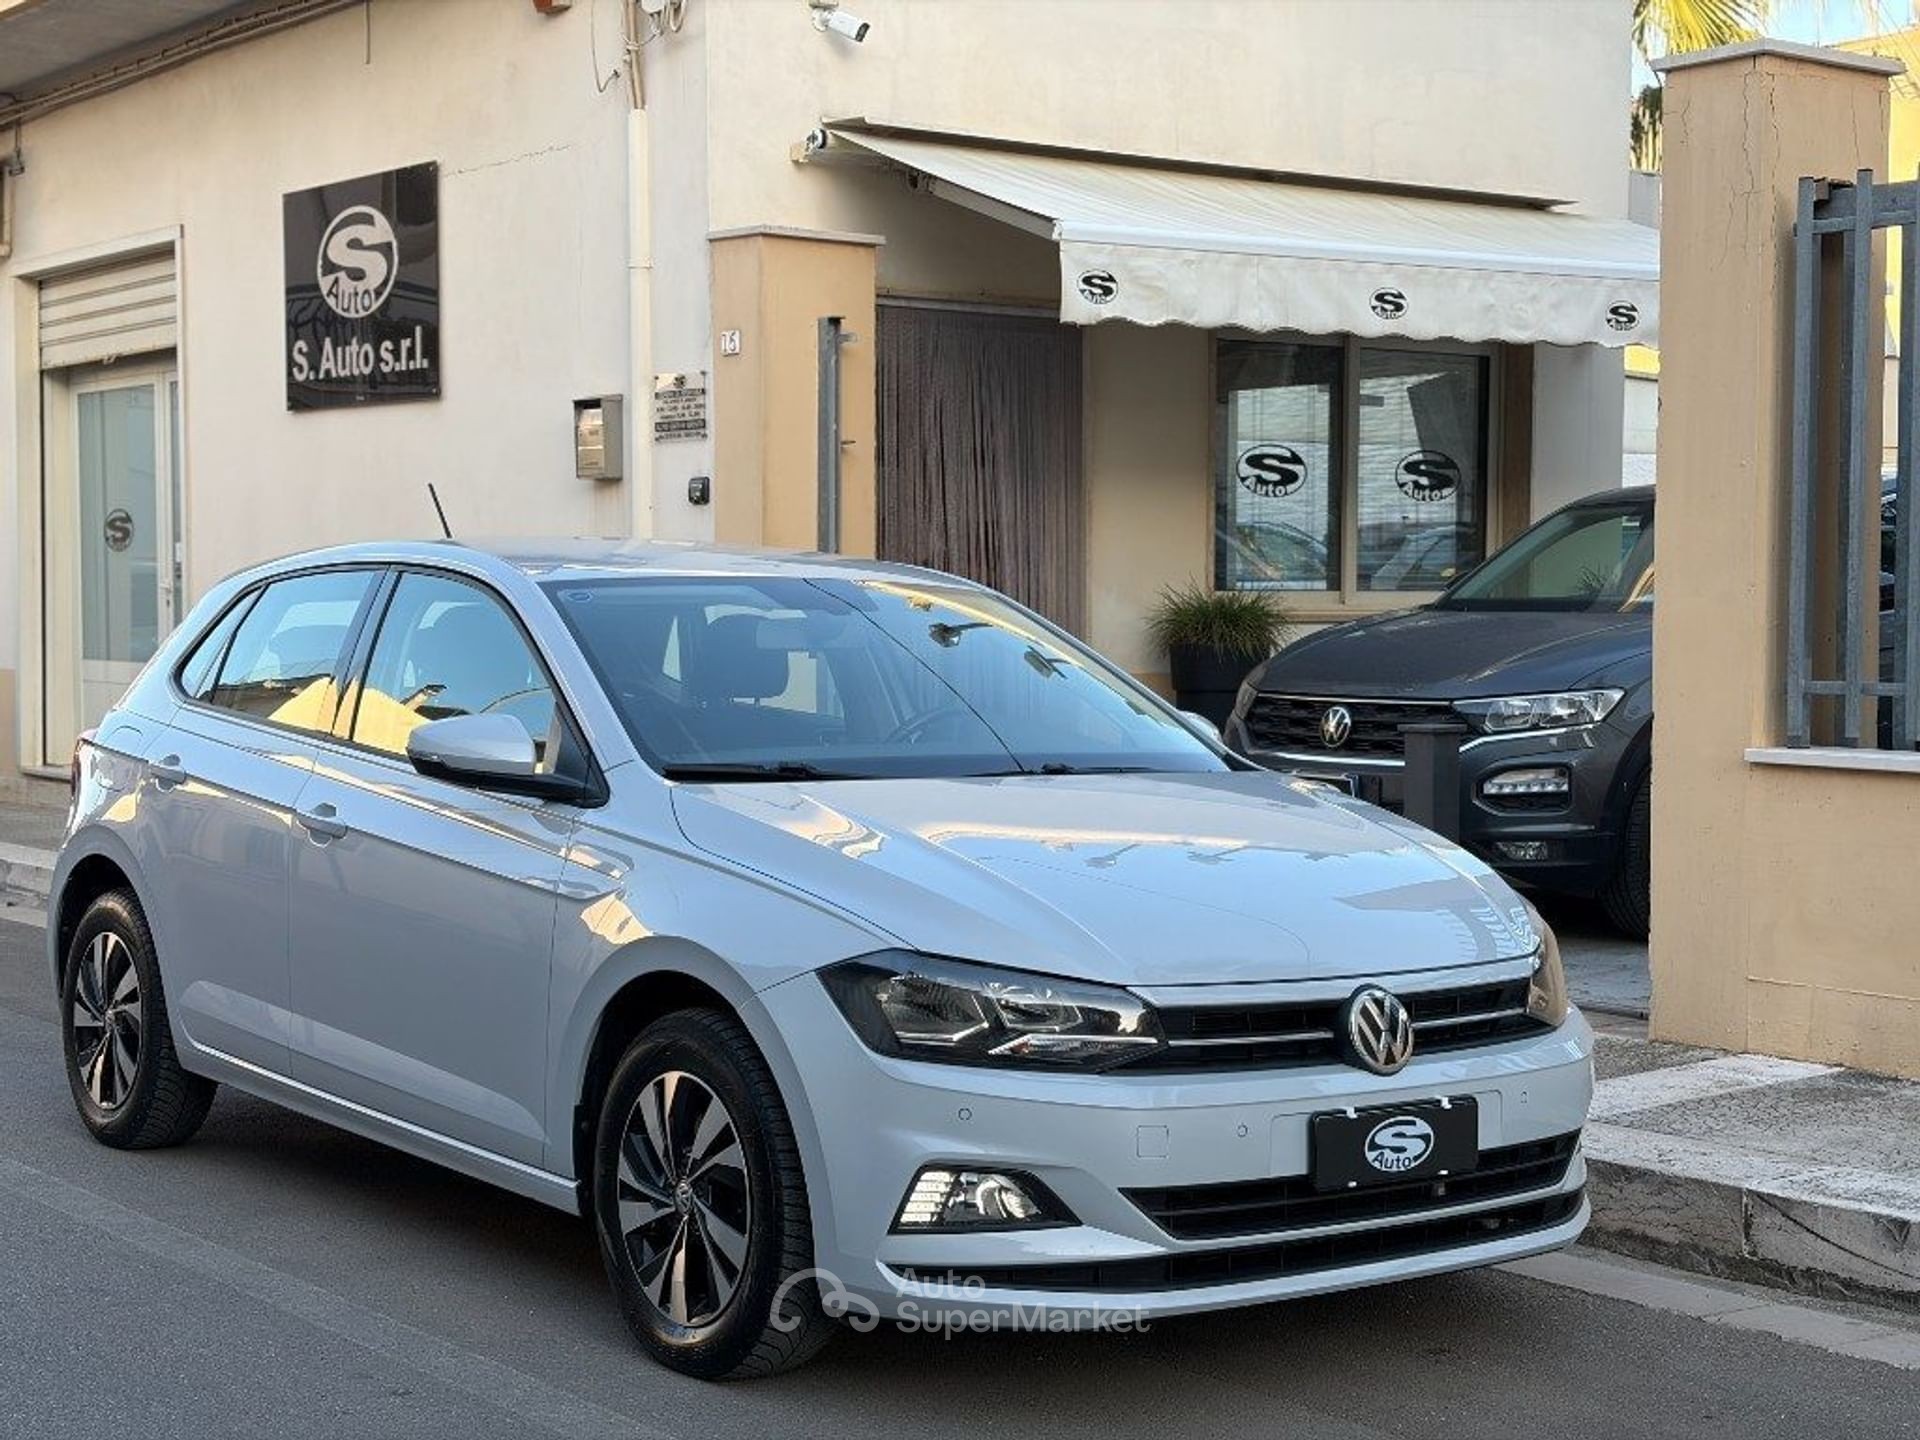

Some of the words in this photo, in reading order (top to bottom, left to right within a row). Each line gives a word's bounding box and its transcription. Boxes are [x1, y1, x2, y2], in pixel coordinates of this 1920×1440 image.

[323, 211, 394, 292] S
[326, 277, 373, 315] Auto
[292, 340, 315, 382] S.
[319, 335, 374, 379] Auto
[379, 325, 429, 373] s.r.l.
[1243, 476, 1287, 497] Auto
[1402, 481, 1441, 502] Auto
[1371, 1118, 1433, 1163] S
[1371, 1150, 1413, 1170] Auto
